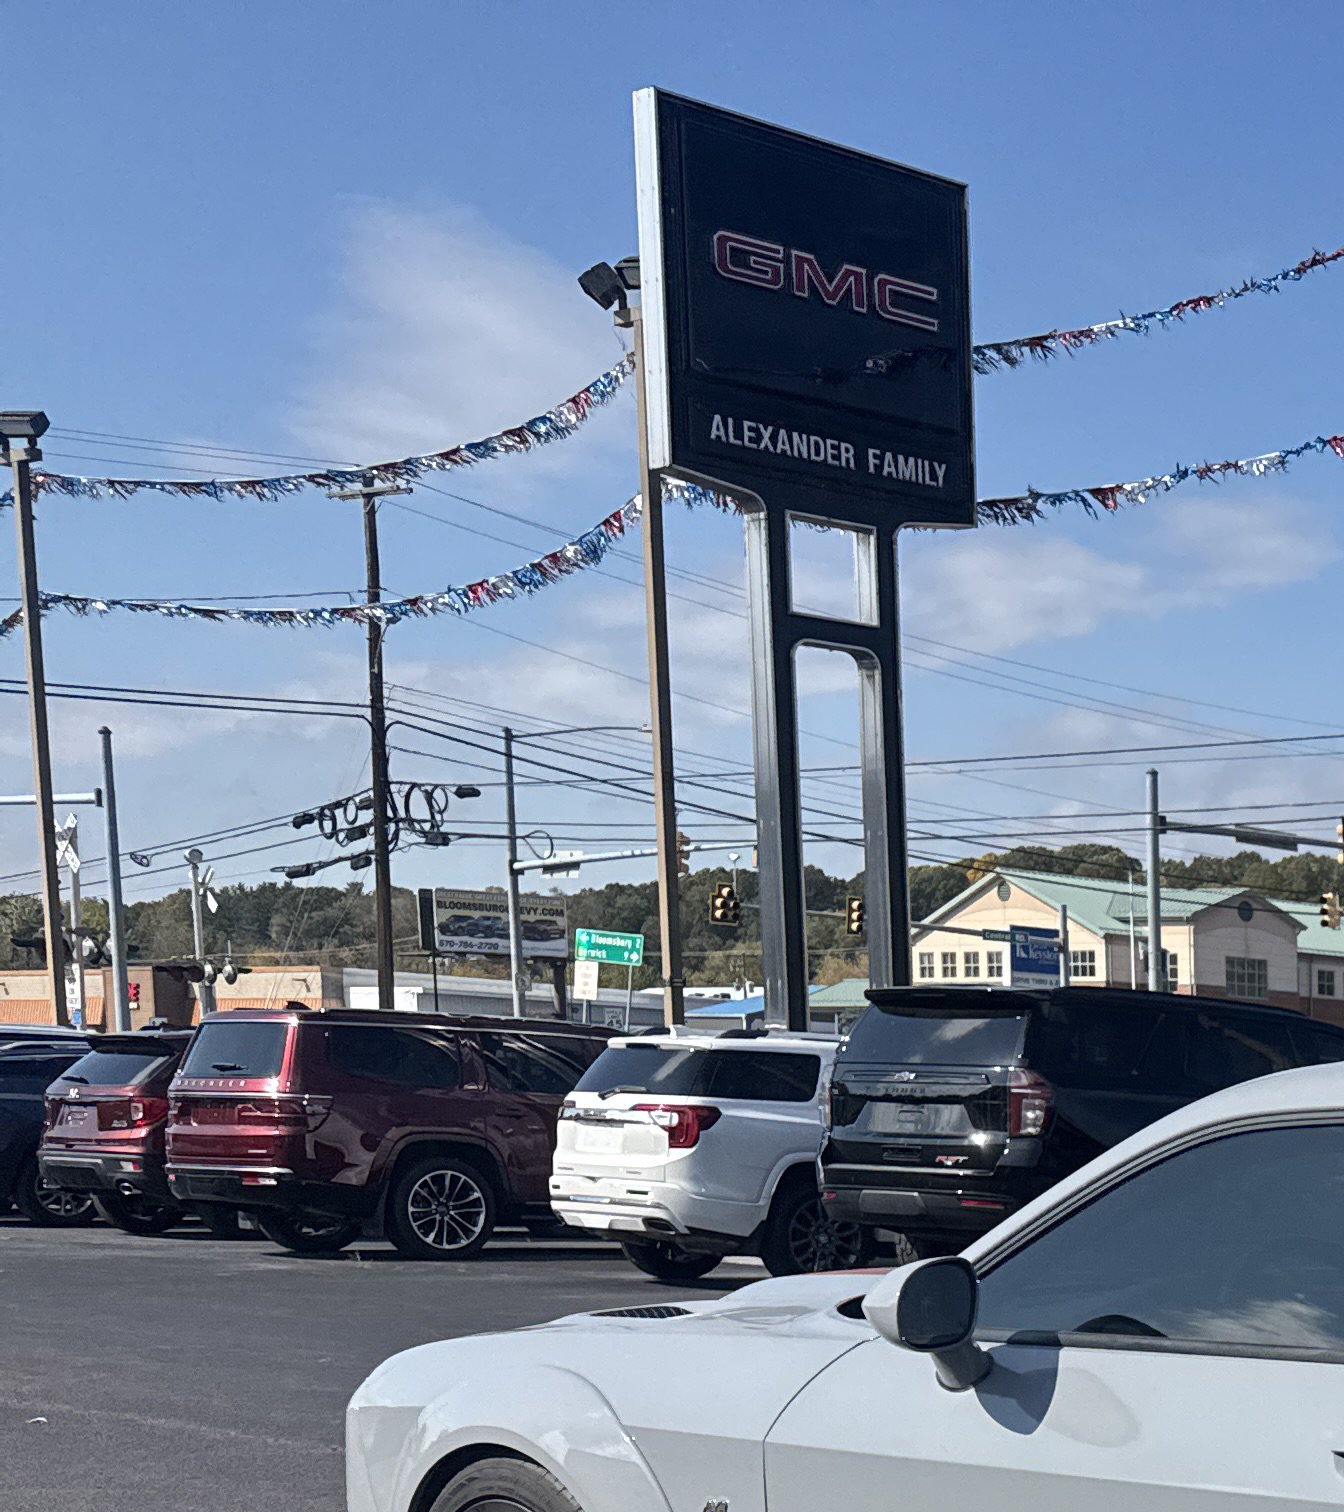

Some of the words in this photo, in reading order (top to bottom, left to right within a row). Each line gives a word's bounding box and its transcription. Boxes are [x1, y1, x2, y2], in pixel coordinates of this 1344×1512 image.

[713, 237, 940, 332] GMC
[709, 413, 857, 471] ALEXANDER
[866, 447, 948, 489] FAMILY
